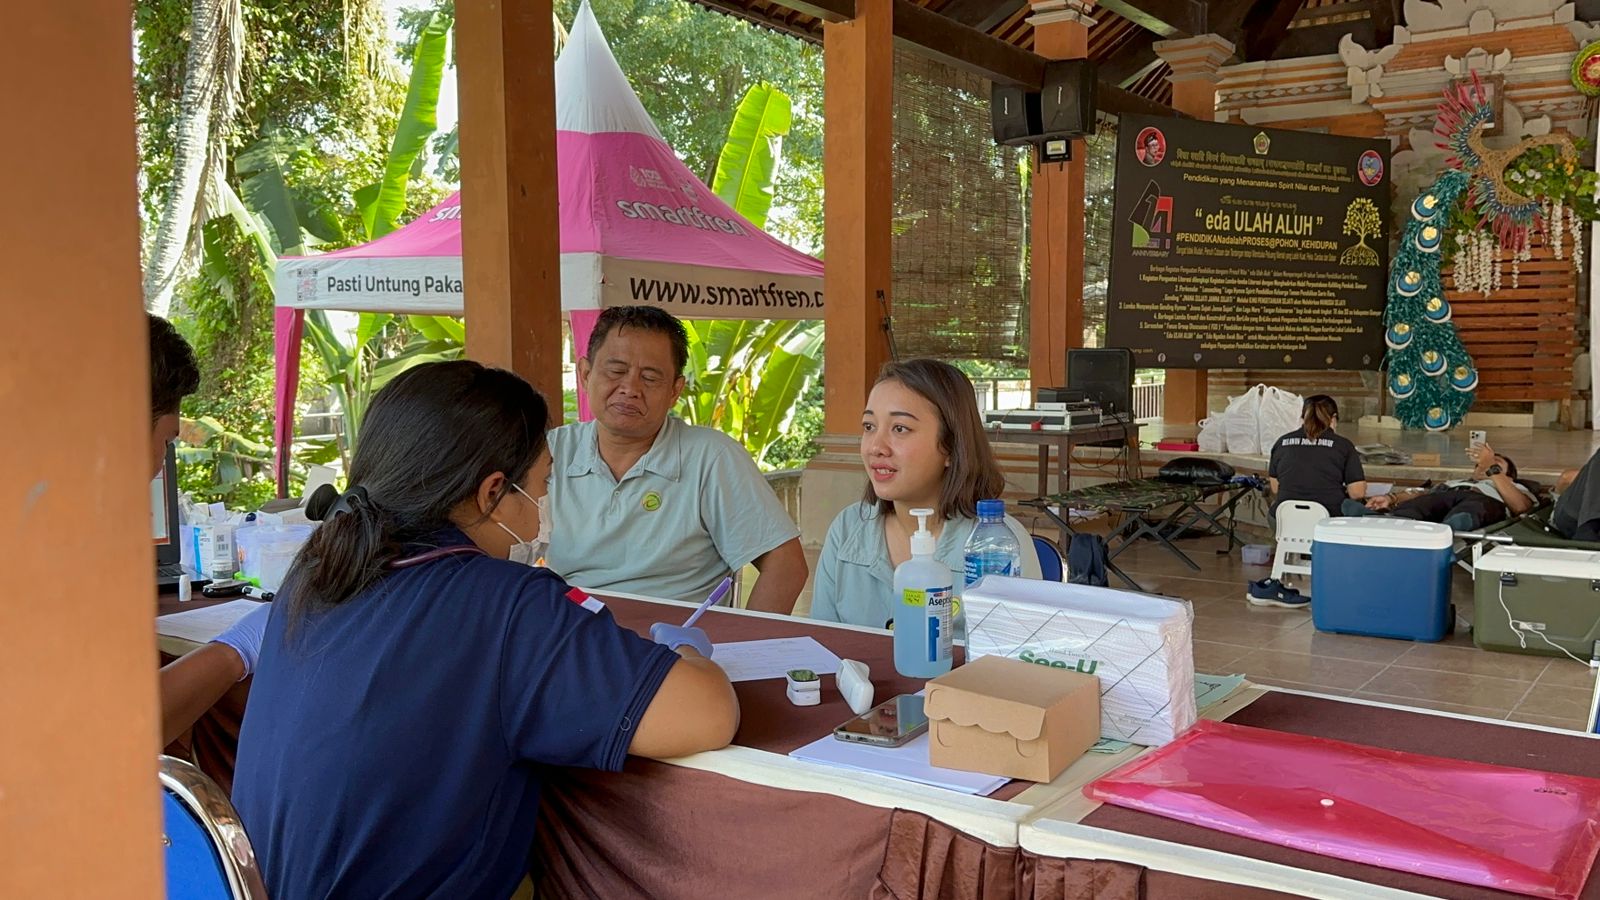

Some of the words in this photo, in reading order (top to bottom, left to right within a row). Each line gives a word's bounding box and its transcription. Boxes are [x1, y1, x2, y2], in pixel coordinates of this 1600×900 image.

[1183, 173, 1219, 184] Pendidikan
[1219, 176, 1236, 186] yang
[1236, 177, 1278, 189] Menanamkan
[1278, 181, 1294, 191] Spirit
[1308, 184, 1321, 193] dan
[615, 200, 750, 238] smartfren
[1205, 209, 1231, 231] eda
[1234, 210, 1273, 234] ULAH
[1275, 213, 1313, 236] ALUH
[327, 274, 362, 293] Pasti
[365, 276, 421, 296] Untung
[424, 275, 463, 293] Paka
[629, 276, 825, 308] www.smartfren.c
